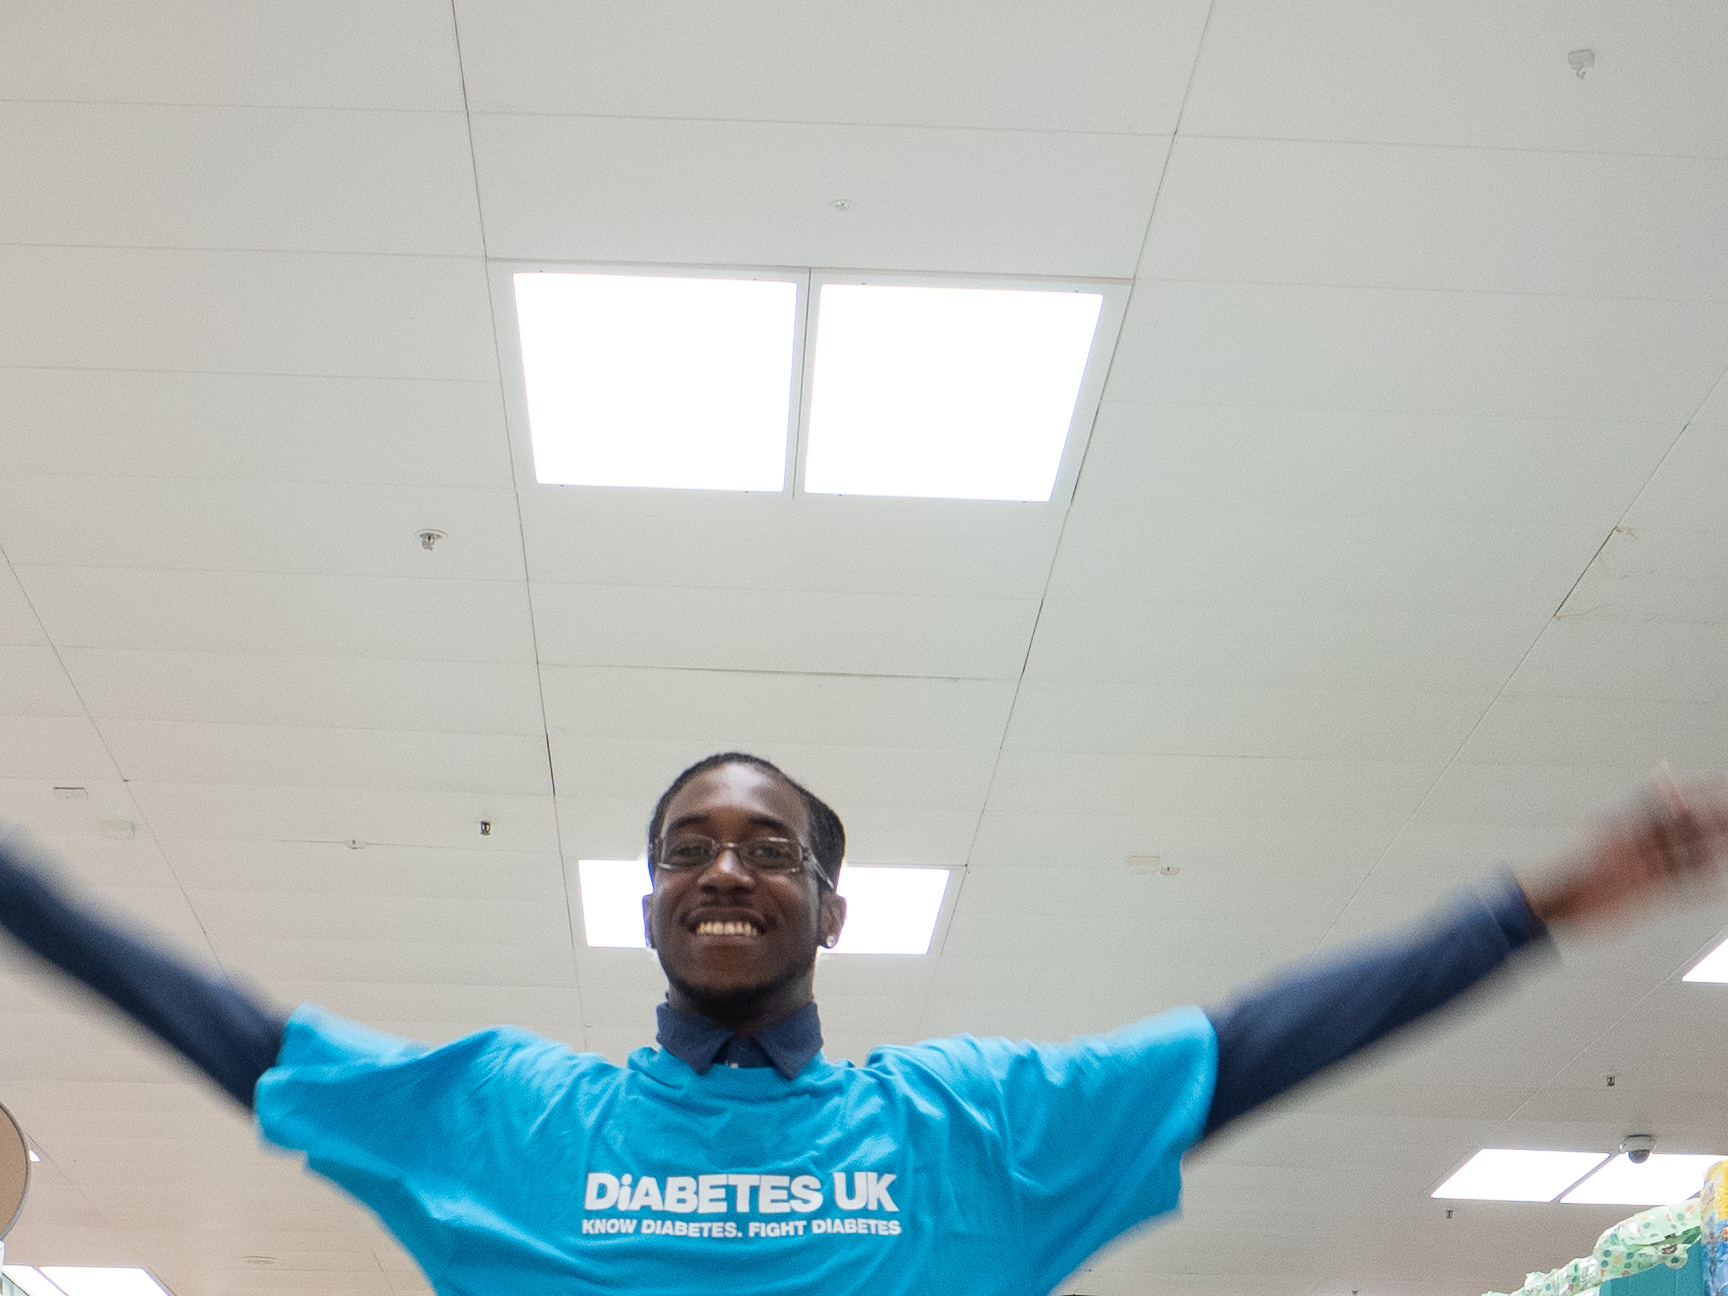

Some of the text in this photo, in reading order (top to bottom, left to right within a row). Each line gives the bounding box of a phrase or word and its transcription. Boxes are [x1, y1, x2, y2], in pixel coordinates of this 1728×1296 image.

[583, 1170, 900, 1214] DiABETES UK
[581, 1217, 903, 1238] KNOW DIABETES. FIGHT DIABETES
